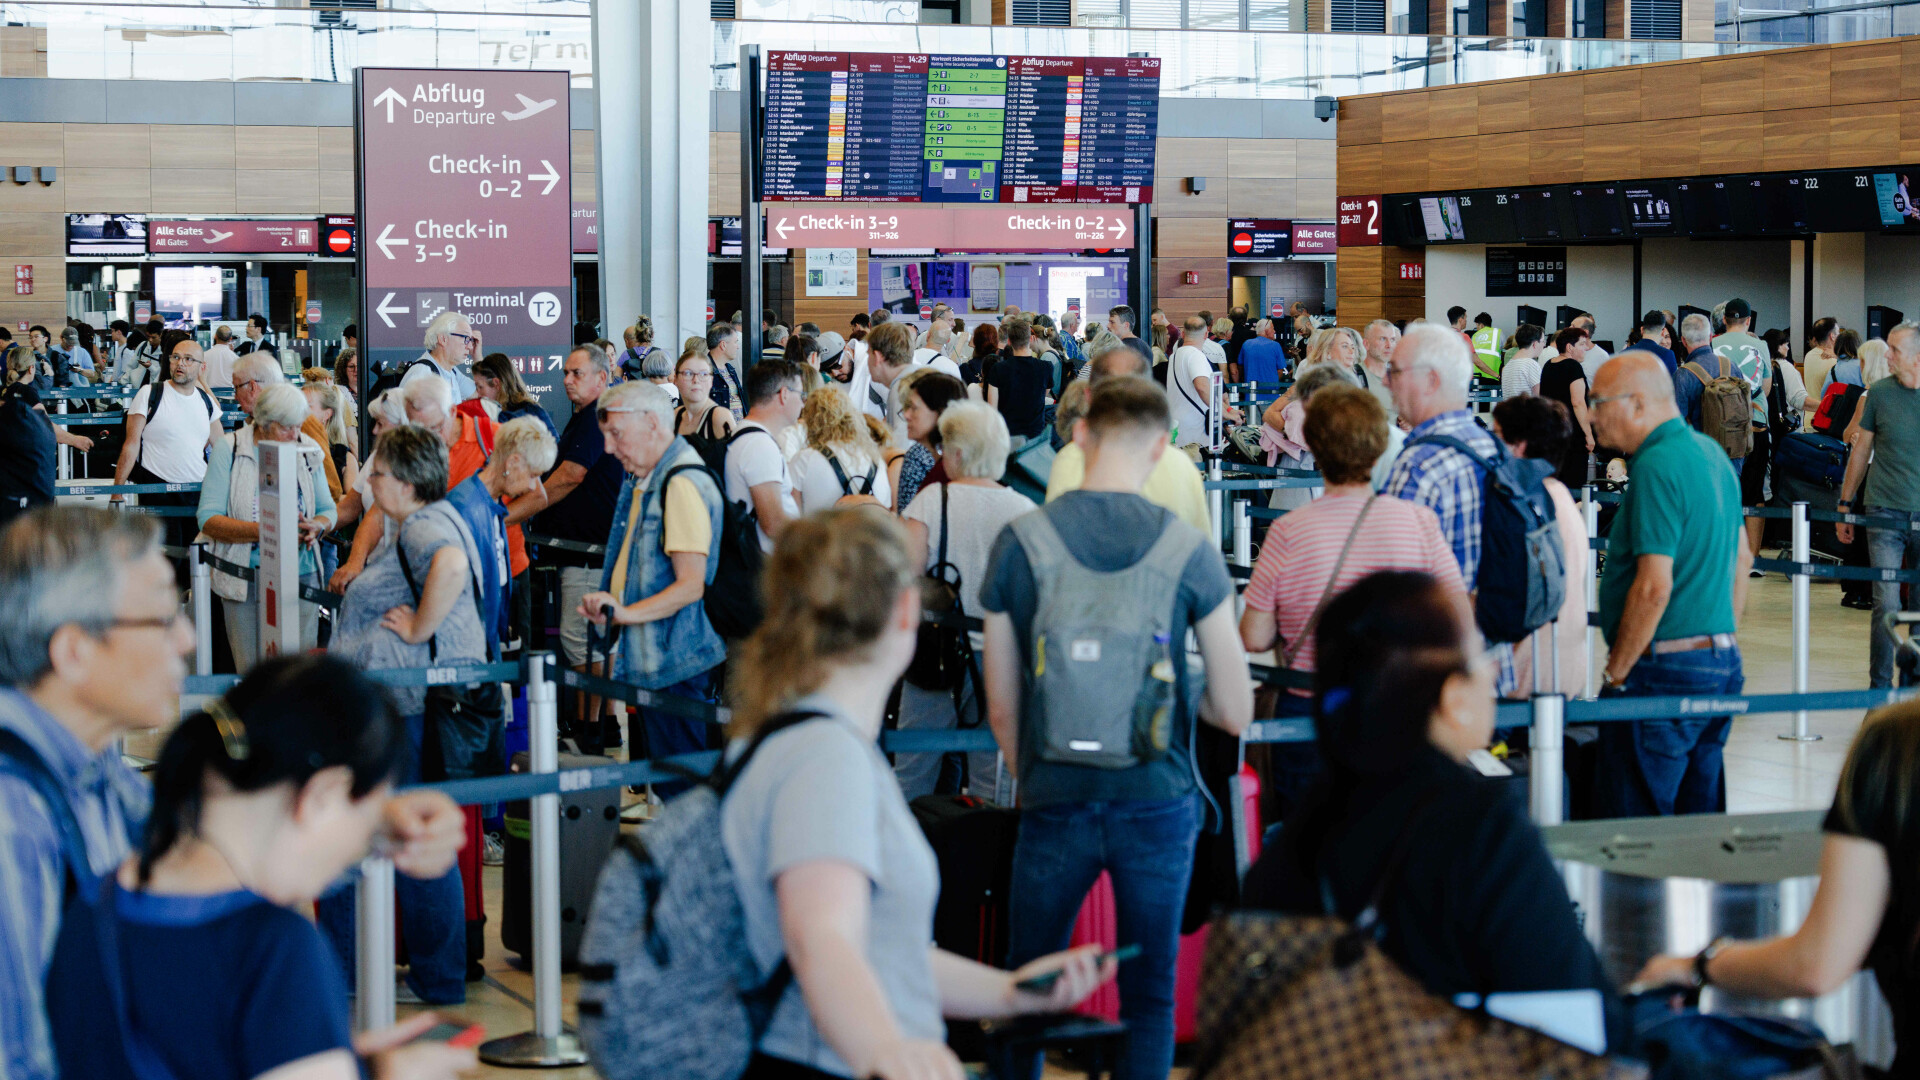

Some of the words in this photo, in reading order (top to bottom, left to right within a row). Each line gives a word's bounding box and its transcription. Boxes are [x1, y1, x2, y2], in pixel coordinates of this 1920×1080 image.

[783, 53, 807, 62] Abflug
[808, 55, 837, 63] Departure
[908, 55, 927, 63] 14:29
[1022, 58, 1044, 67] Abflug
[1046, 59, 1073, 67] Departure
[413, 83, 485, 108] Abflug
[414, 109, 495, 128] Departure
[429, 154, 521, 174] Check-in
[1804, 178, 1819, 189] 222
[1855, 176, 1868, 187] 221
[1460, 196, 1472, 206] 226
[1496, 194, 1508, 205] 225
[329, 217, 342, 225] BER
[799, 215, 865, 230] Check-in
[1008, 215, 1071, 230] Check-in
[1341, 201, 1362, 211] Check-in
[1367, 200, 1378, 235] 2
[156, 226, 174, 236] Alle
[176, 226, 203, 236] Gates
[415, 219, 508, 239] Check-in
[1297, 230, 1313, 239] Alle
[1314, 230, 1336, 239] Gates
[156, 238, 166, 246] All
[167, 238, 188, 246] Gates
[454, 292, 525, 307] Terminal
[533, 301, 556, 317] T2
[469, 313, 492, 325] 500
[497, 315, 508, 324] m
[526, 385, 552, 393] Airport
[166, 483, 182, 492] BER
[1258, 480, 1273, 488] BER
[70, 487, 86, 495] BER
[130, 507, 146, 515] BER
[1845, 514, 1856, 523] BER
[426, 668, 458, 684] BER
